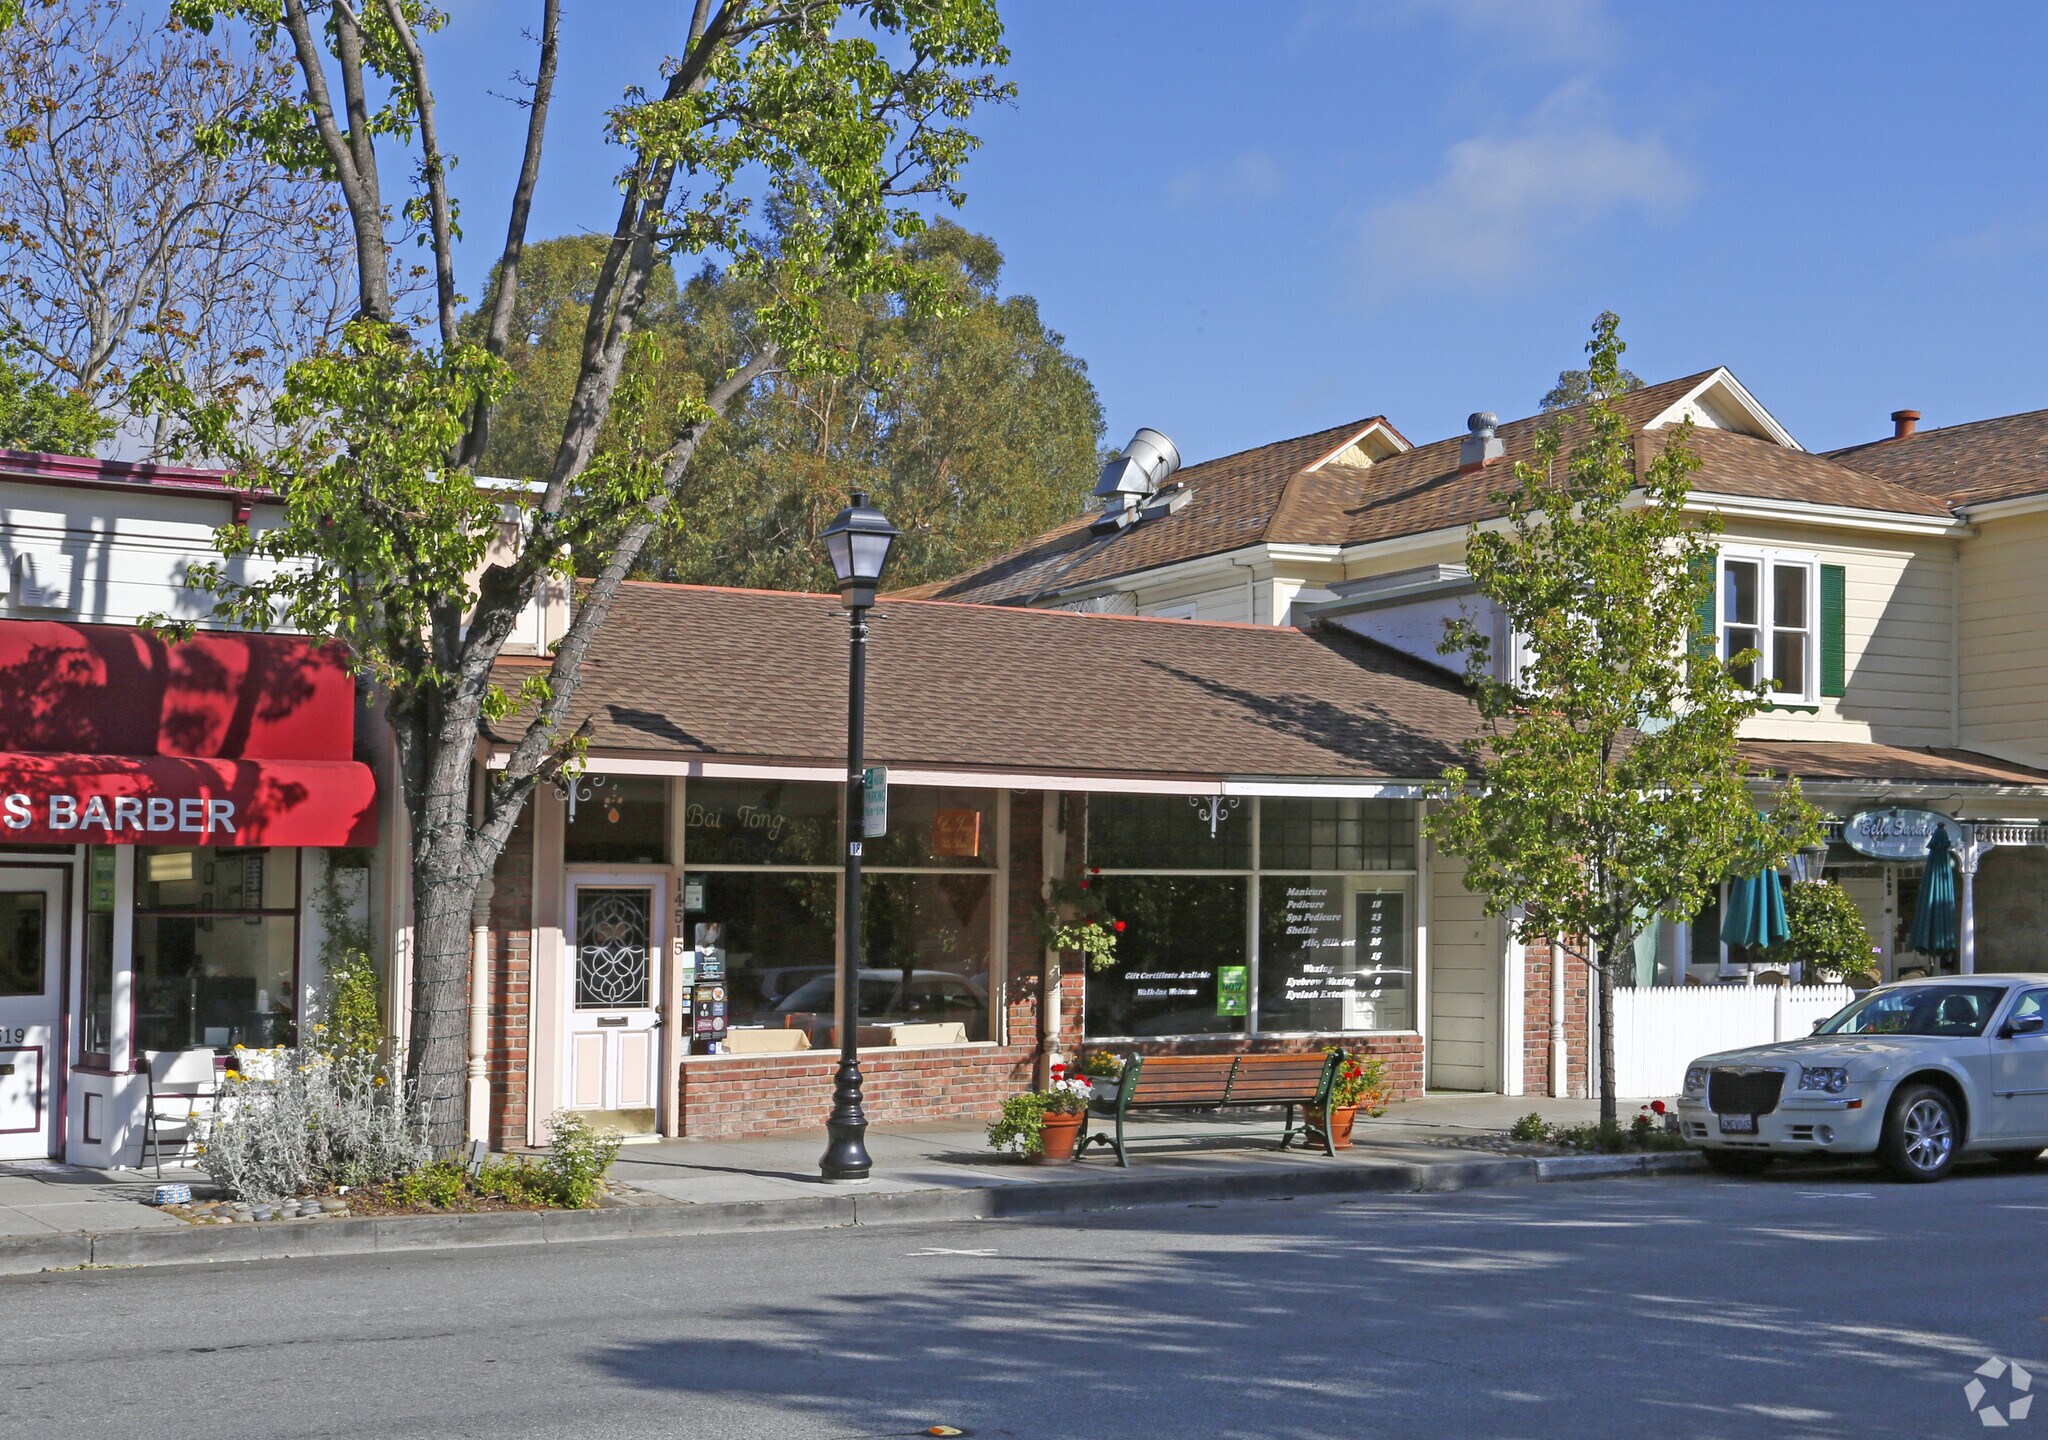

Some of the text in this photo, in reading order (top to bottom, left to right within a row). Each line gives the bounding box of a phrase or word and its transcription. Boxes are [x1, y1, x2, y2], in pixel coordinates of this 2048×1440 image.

[865, 772, 873, 788] 2
[865, 790, 885, 803] PARKING
[0, 789, 236, 833] S BARBER
[686, 803, 783, 840] Bai Tong
[1860, 816, 1891, 836] Bella
[852, 843, 861, 855] 18
[1286, 888, 1327, 896] Manicure
[1286, 900, 1324, 909] Pedicure
[674, 878, 685, 955] 14515
[1286, 913, 1382, 923] Spa Pedicure 23
[1286, 926, 1382, 935] Shellac 25
[1322, 938, 1340, 947] Silk
[1369, 938, 1382, 946] 35
[1371, 952, 1382, 960] 15
[1303, 964, 1334, 974] Waxing
[1125, 971, 1211, 980] Gift Certificate Available
[1222, 983, 1241, 991] NOW
[1285, 977, 1323, 988] Eyebrow
[1325, 977, 1356, 987] Waxing
[1169, 988, 1198, 996] Welcome
[1285, 989, 1382, 1000] Eyelash Extensions 45
[0, 1028, 25, 1044] 19
